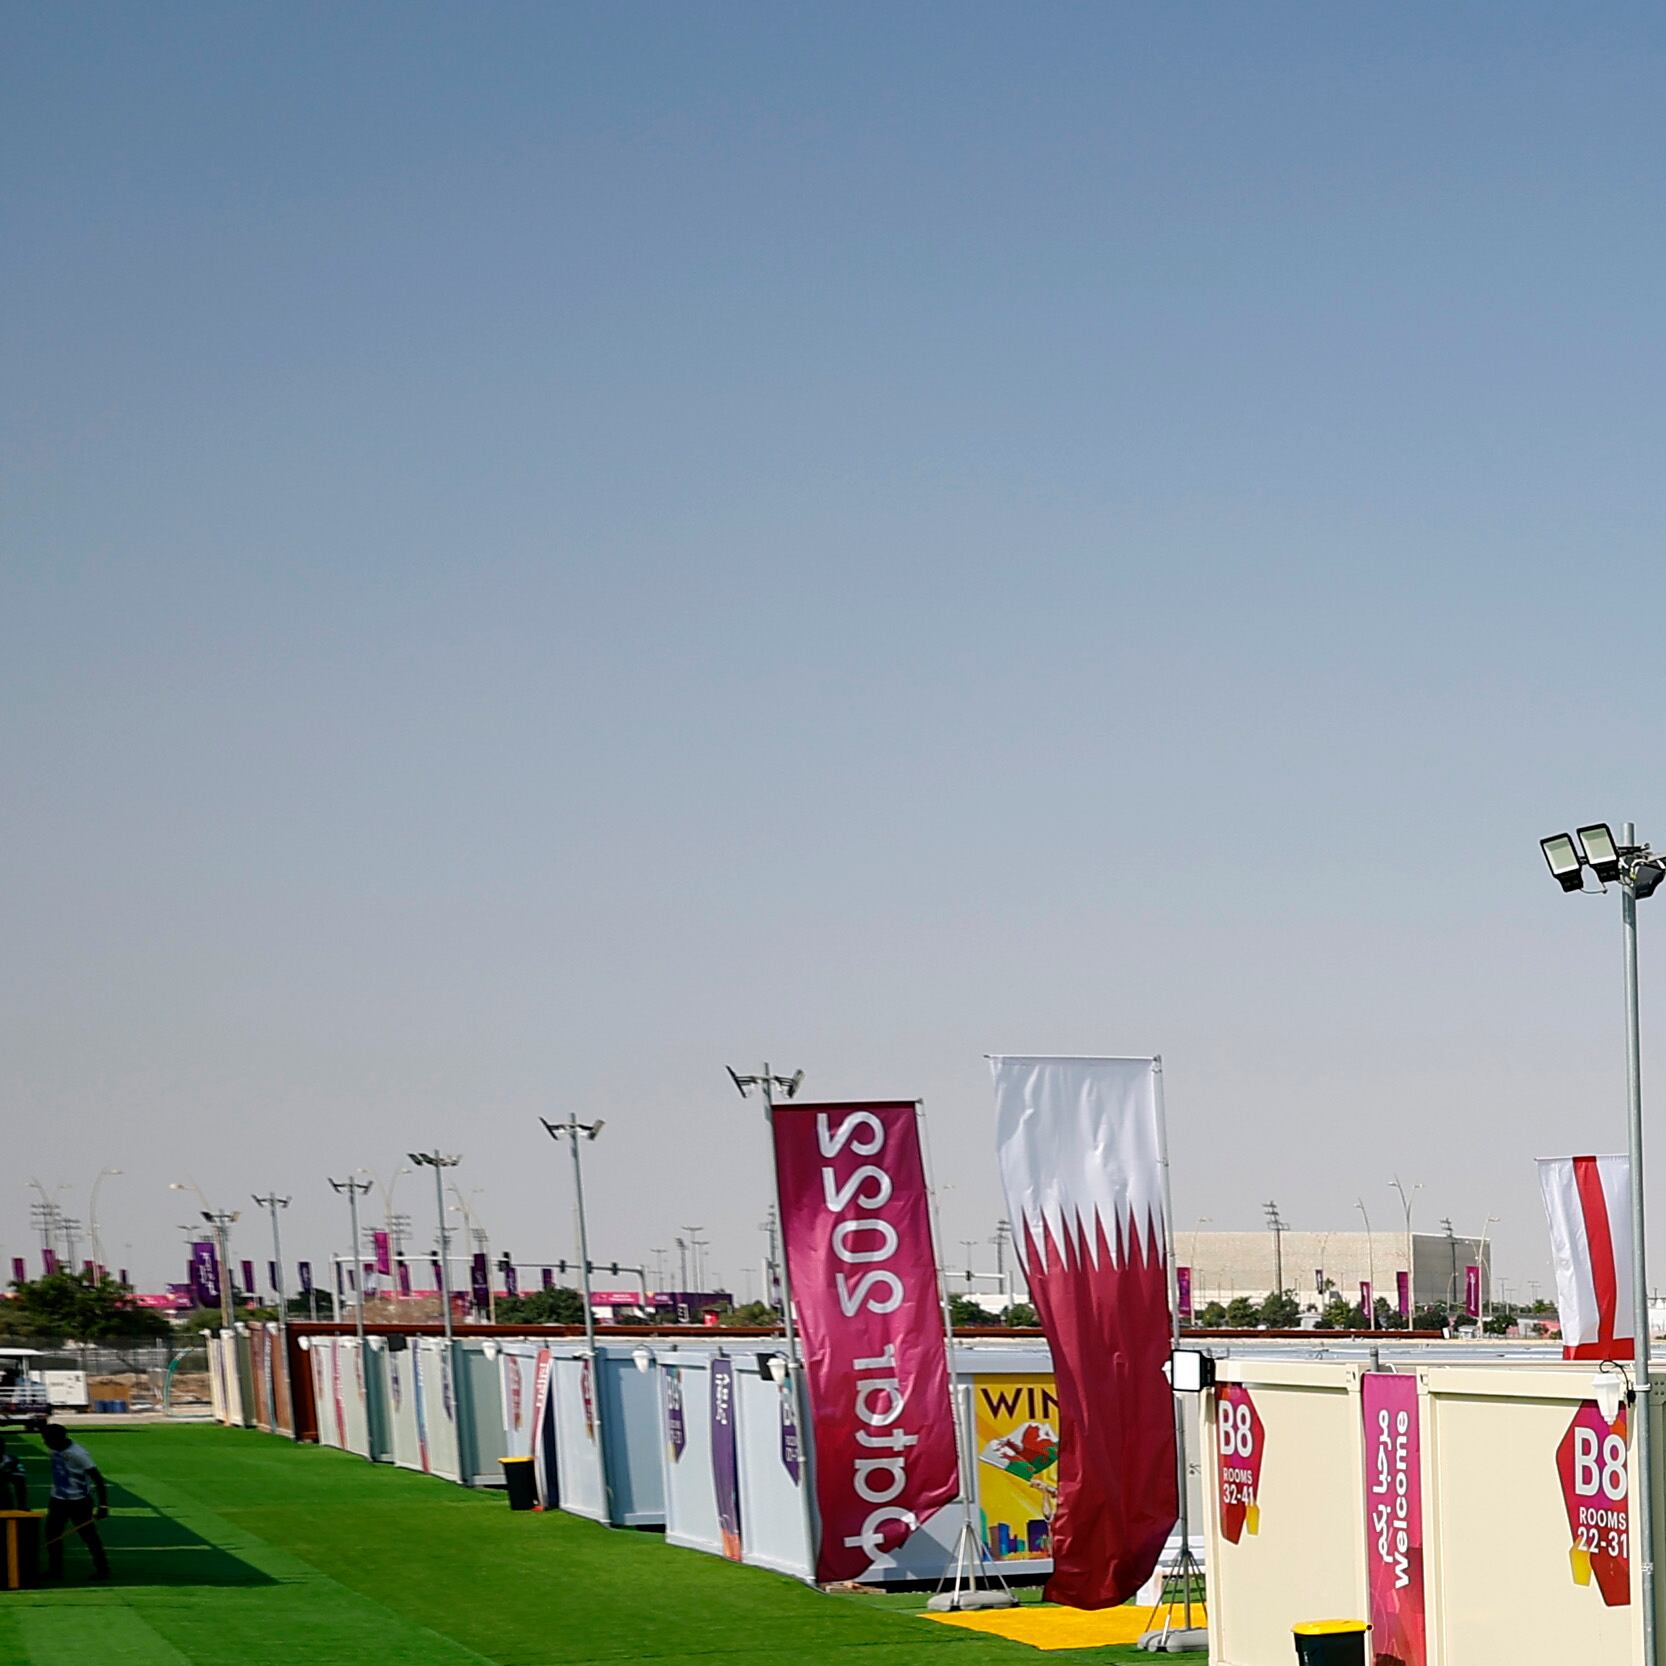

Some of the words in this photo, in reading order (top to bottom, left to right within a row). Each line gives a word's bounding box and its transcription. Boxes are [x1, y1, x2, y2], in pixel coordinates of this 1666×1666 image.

[1218, 1400, 1253, 1458] B8
[1372, 1410, 1392, 1494] مرحبا
[1223, 1467, 1253, 1484] ROOMS
[1574, 1427, 1628, 1501] B8
[1223, 1482, 1254, 1505] 32-41
[1393, 1411, 1410, 1589] Welcome
[1579, 1506, 1627, 1531] ROOMS
[1372, 1504, 1394, 1563] بكم
[1577, 1526, 1628, 1559] 22-31
